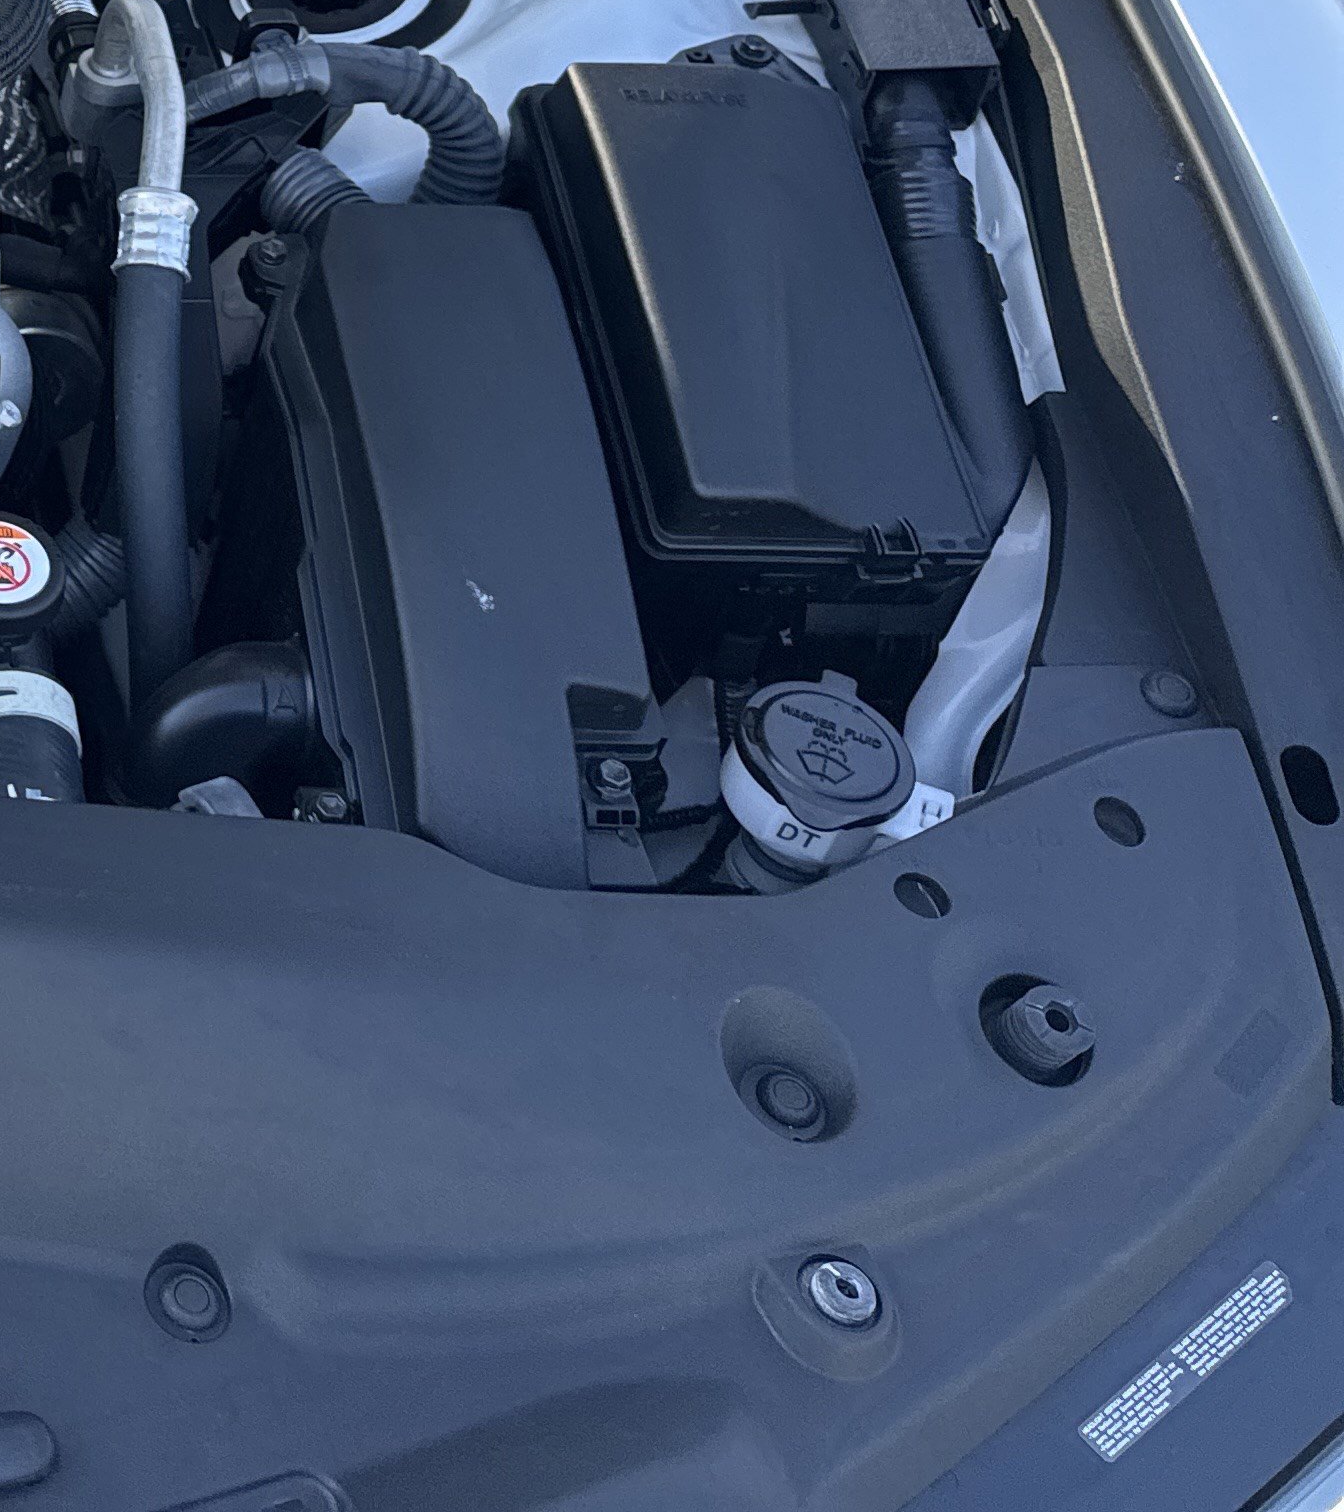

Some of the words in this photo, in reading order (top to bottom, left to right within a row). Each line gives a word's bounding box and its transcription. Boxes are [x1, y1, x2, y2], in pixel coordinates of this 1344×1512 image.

[781, 703, 837, 732] WASHER
[844, 727, 883, 750] FLUID
[812, 727, 847, 746] ONLY
[776, 821, 821, 848] DT
